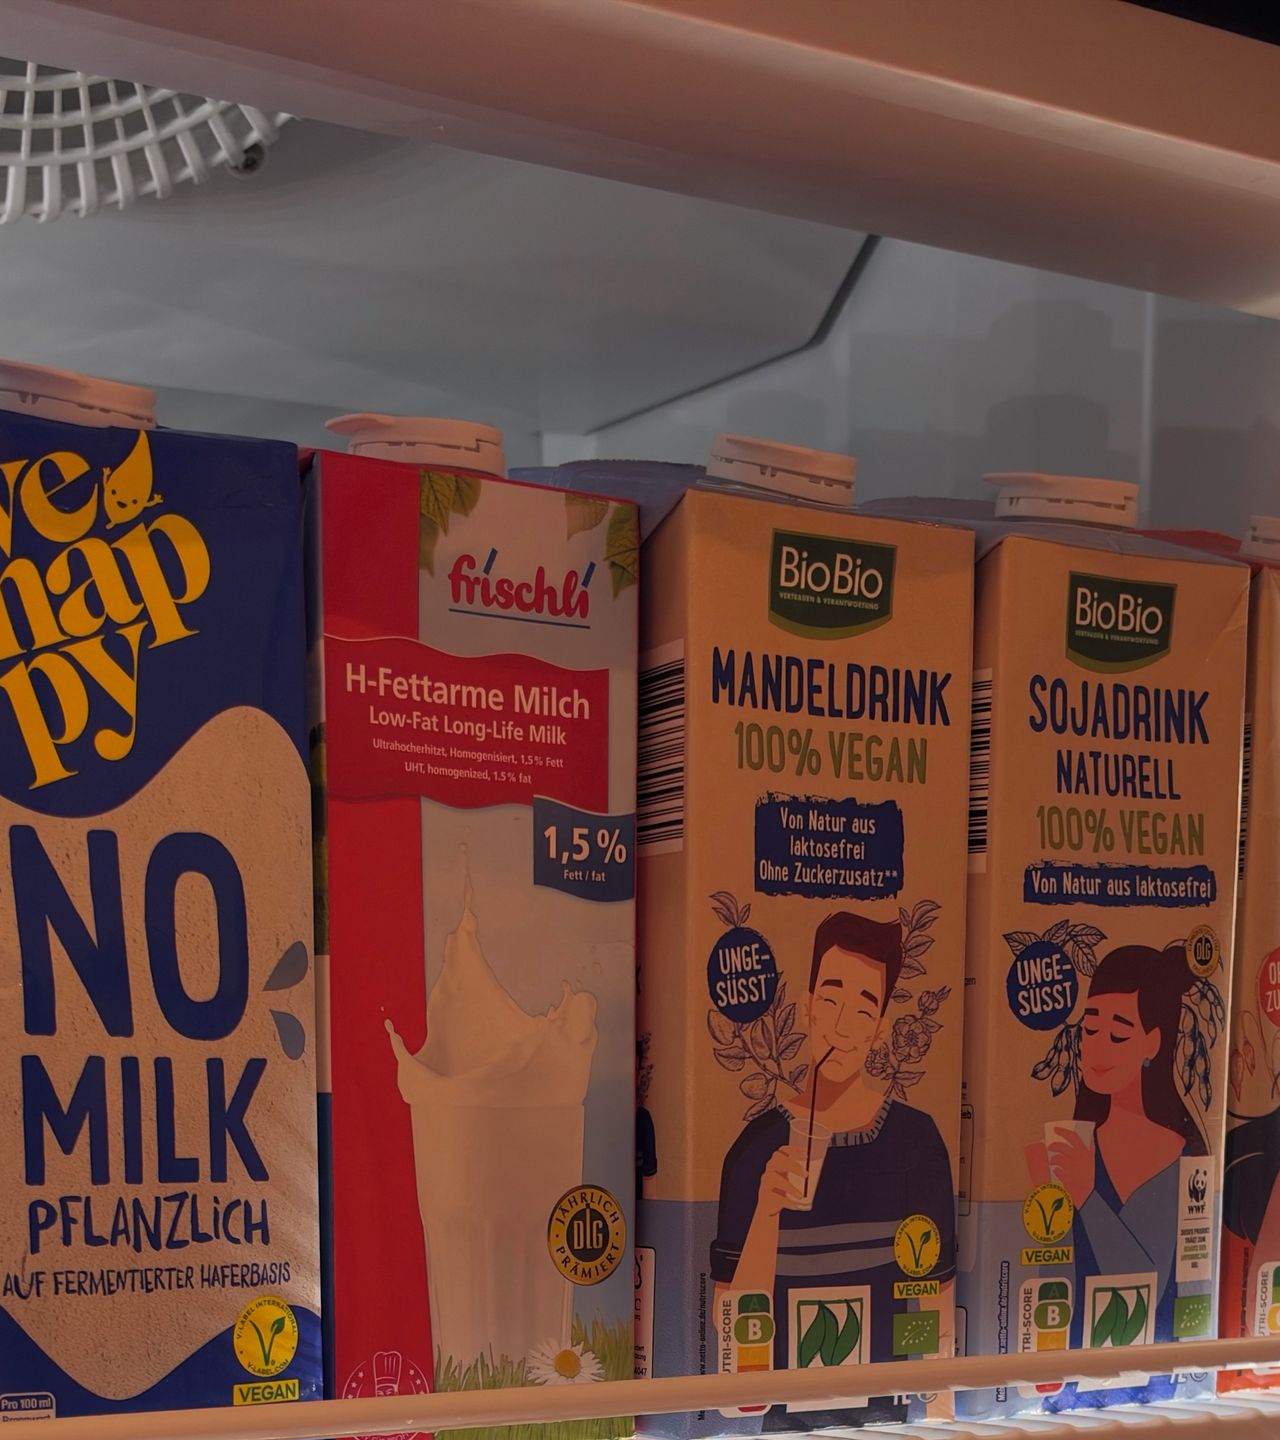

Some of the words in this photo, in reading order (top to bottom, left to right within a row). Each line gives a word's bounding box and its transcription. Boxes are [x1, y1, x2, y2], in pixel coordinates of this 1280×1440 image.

[448, 547, 596, 619] frischli
[780, 545, 883, 599] BioBio
[1076, 587, 1163, 634] BioBio
[345, 662, 504, 711] H-Fettarme
[514, 684, 590, 720] Milch
[712, 646, 952, 727] MANDELDRINK
[370, 705, 439, 732] Low-Fat
[444, 715, 524, 742] Long-Life
[529, 725, 567, 745] Milk
[1029, 674, 1210, 745] SOJADRINK
[450, 747, 518, 765] Homogenisiert,
[546, 757, 564, 768] Fett
[735, 721, 820, 777] 100%
[828, 730, 928, 785] VEGAN
[427, 765, 491, 782] homogenized,
[518, 772, 532, 784] fat
[1056, 750, 1181, 800] NATURELL
[780, 806, 803, 830] Von
[809, 809, 847, 833] Natur
[852, 817, 876, 835] aus
[1036, 806, 1114, 854] 100%
[1120, 809, 1205, 856] VEGAN
[790, 835, 865, 860] laktosefrei
[563, 869, 583, 881] Fett
[591, 870, 606, 882] fat
[759, 859, 789, 880] Ohne
[1032, 870, 1057, 894] Von
[1063, 871, 1102, 895] Natur
[1107, 878, 1131, 897] aus
[1136, 874, 1212, 899] laktosefrei
[9, 824, 248, 1040] NO
[718, 943, 770, 975] UNGE-
[1016, 953, 1072, 986] UNGE-
[1018, 981, 1072, 1016] SÜSST
[21, 1054, 269, 1186] MILK
[1187, 1204, 1206, 1215] WWF
[573, 1206, 603, 1250] DLG
[1025, 1249, 1070, 1263] VEGAN
[2, 1268, 48, 1300] AUF
[53, 1264, 194, 1297] FERMENTIERTER
[199, 1259, 292, 1291] HAFERBASIS
[897, 1283, 937, 1297] VEGAN
[748, 1318, 762, 1341] B
[1047, 1305, 1060, 1326] B
[1, 1399, 18, 1411] Pro
[20, 1398, 37, 1409] 100
[38, 1397, 51, 1408] ml
[238, 1383, 296, 1402] VEGAN
